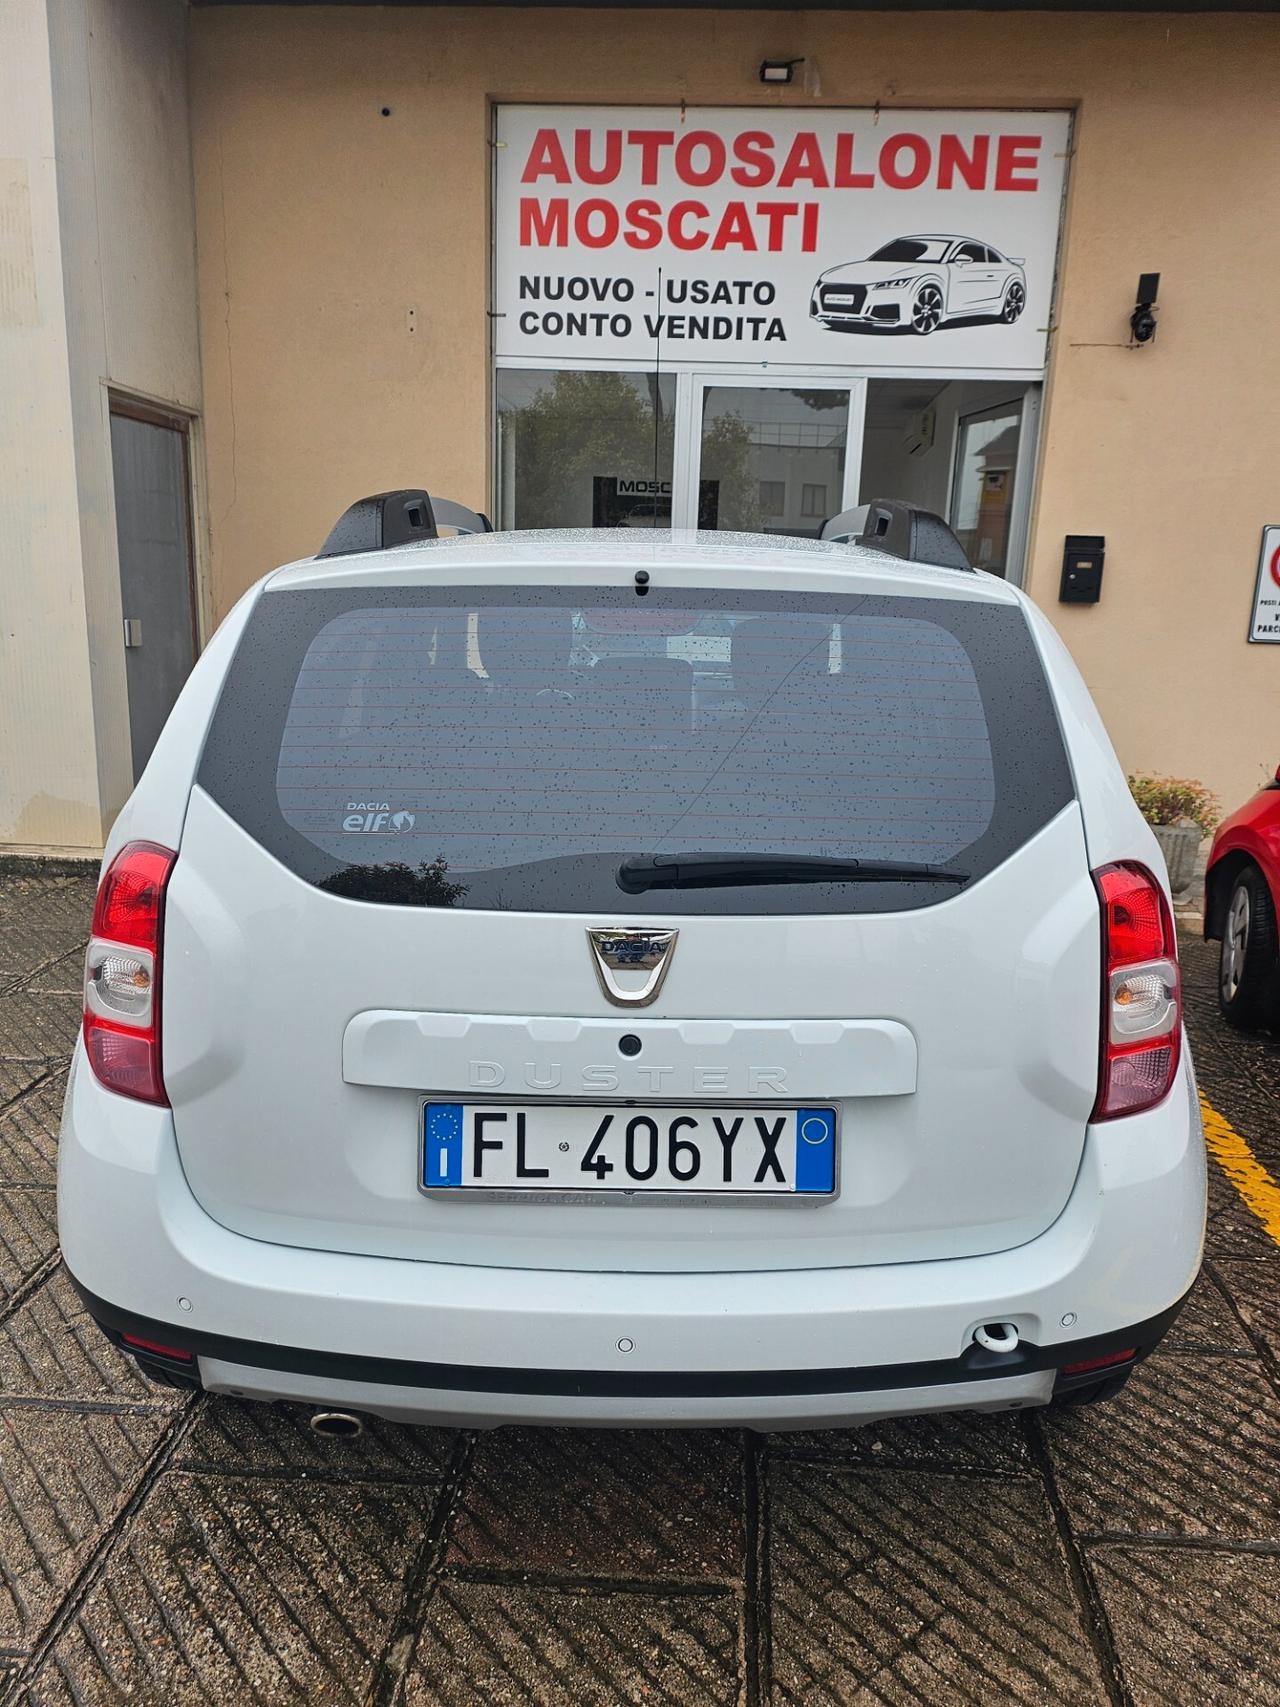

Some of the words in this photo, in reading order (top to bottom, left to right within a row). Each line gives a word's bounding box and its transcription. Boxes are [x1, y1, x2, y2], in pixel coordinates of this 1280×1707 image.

[520, 128, 1042, 193] AUTOSALONE
[519, 197, 820, 254] MOSCATI
[519, 275, 634, 301] NUOVO
[667, 279, 776, 306] USATO
[519, 311, 632, 337] CONTO
[644, 314, 787, 341] VENDITA
[1257, 625, 1280, 633] PARC
[347, 803, 390, 811] DACIA
[342, 813, 389, 832] elf
[602, 940, 662, 954] DACIA
[469, 1060, 789, 1093] DUSTER
[473, 1112, 550, 1178] FL
[580, 1115, 787, 1183] 406YX
